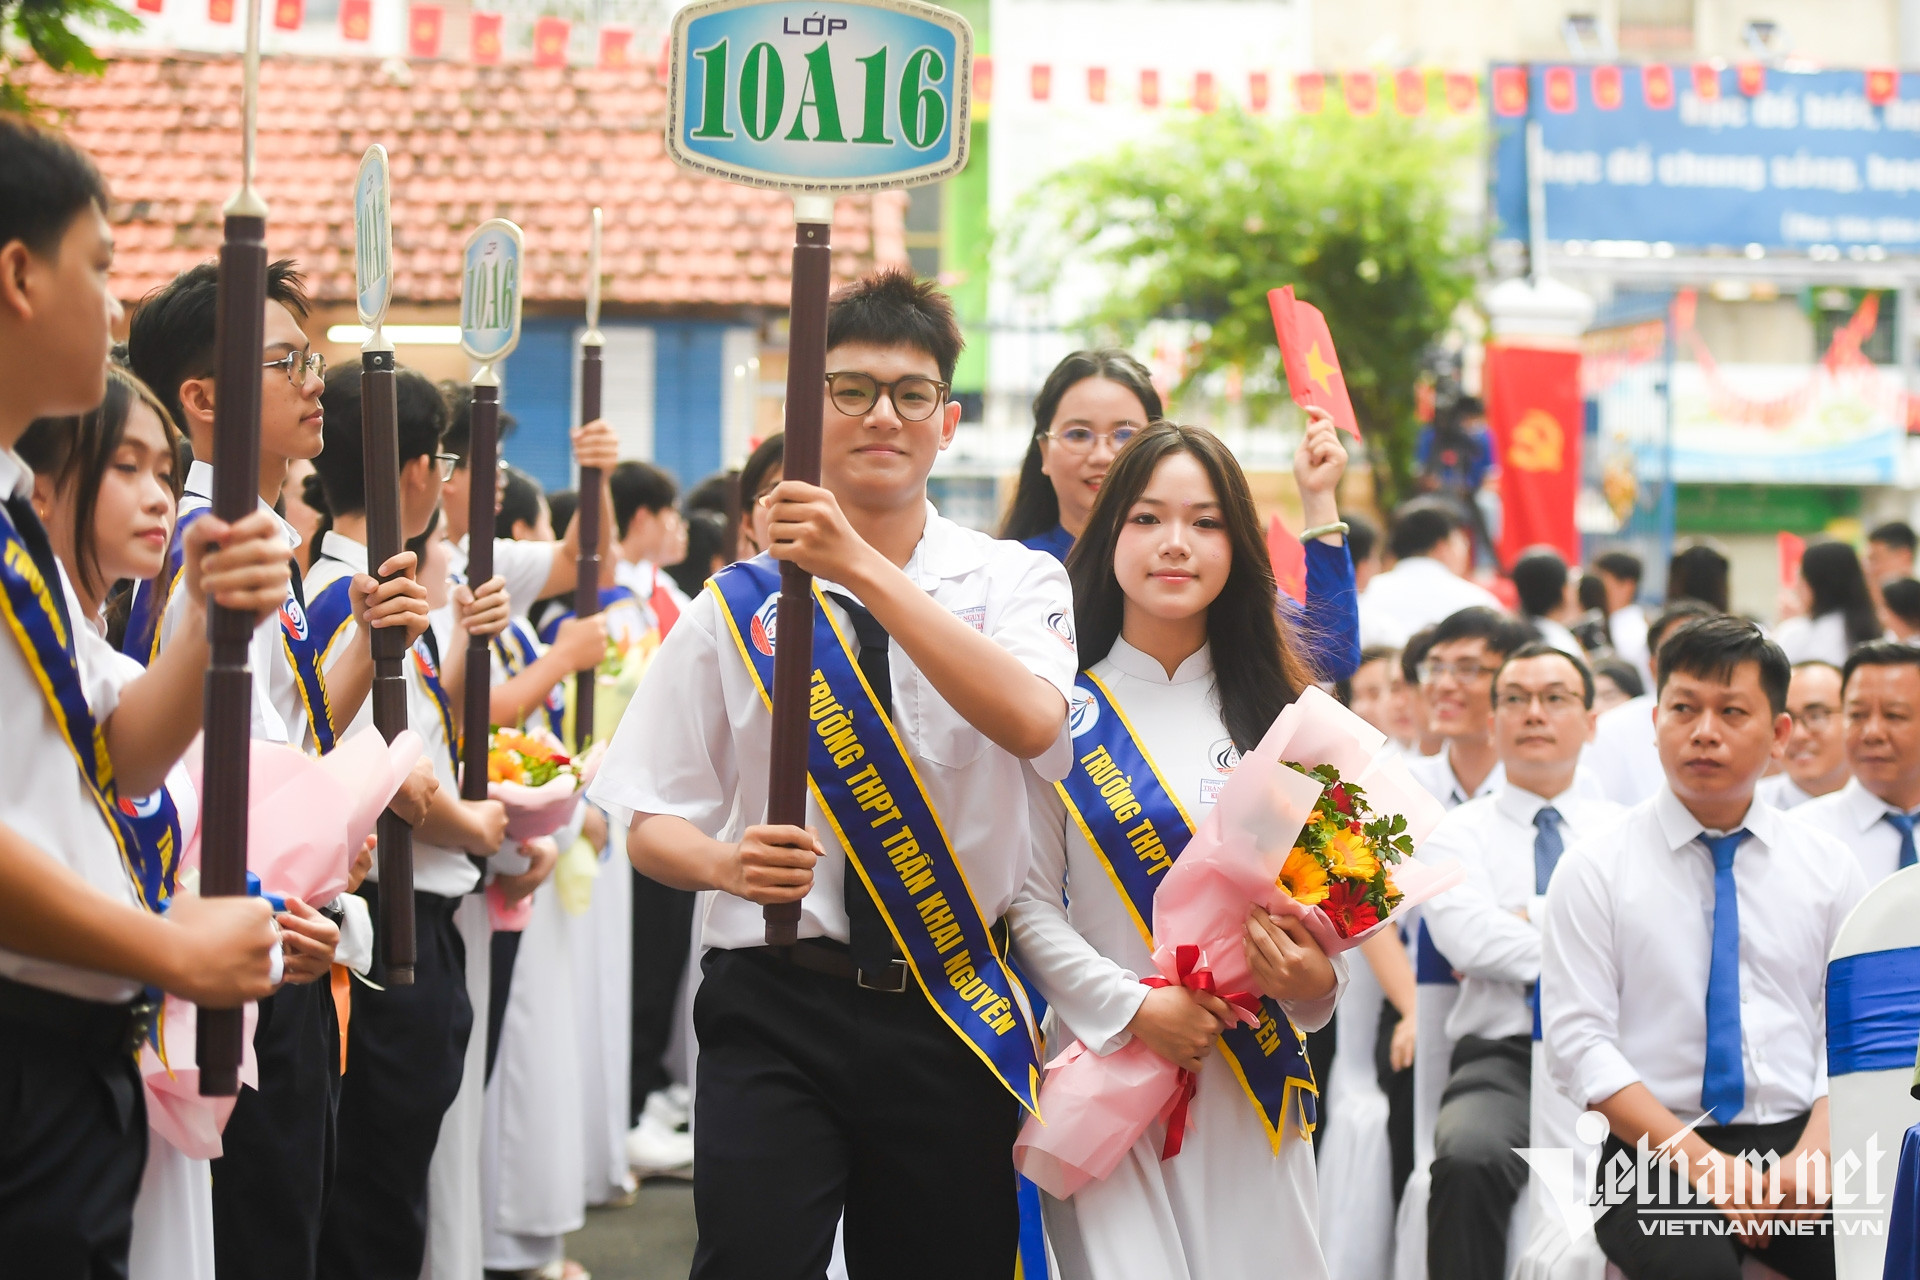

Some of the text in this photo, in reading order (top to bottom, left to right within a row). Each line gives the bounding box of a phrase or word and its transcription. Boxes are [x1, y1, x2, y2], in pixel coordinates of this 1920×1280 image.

[783, 11, 848, 36] LỚP
[692, 39, 945, 149] 10A16
[465, 259, 513, 329] 10A6
[809, 668, 1017, 1037] TRƯỜNG THPT TRẦN KHAI NGUYÊN
[1080, 744, 1142, 824] TRƯỜNG
[1126, 818, 1174, 876] THPT
